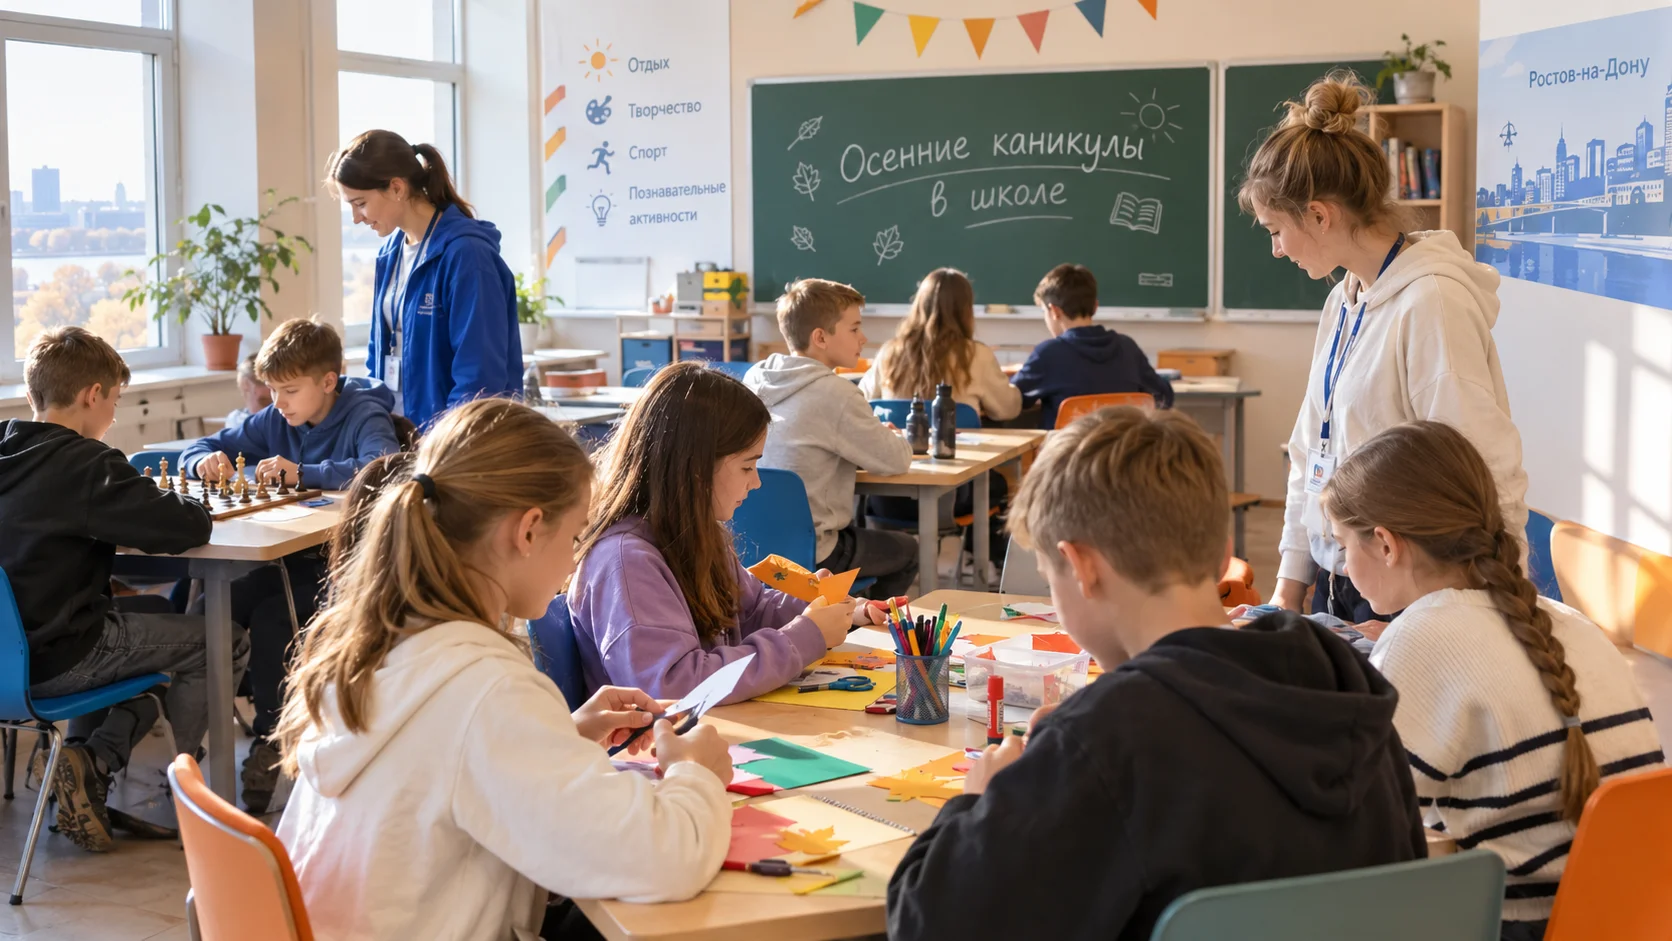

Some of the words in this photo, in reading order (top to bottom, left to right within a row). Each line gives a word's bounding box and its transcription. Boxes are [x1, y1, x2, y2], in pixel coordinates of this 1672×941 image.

[628, 57, 670, 74] Отдых
[1529, 57, 1650, 88] Ростов-на-Дону
[628, 101, 702, 121] Творчество
[628, 145, 667, 162] Спорт
[840, 136, 970, 183] Осенние
[993, 131, 1144, 173] каникулы
[629, 182, 726, 201] Познавательные
[931, 180, 947, 217] в
[971, 182, 1067, 211] школе
[629, 210, 698, 226] активности
